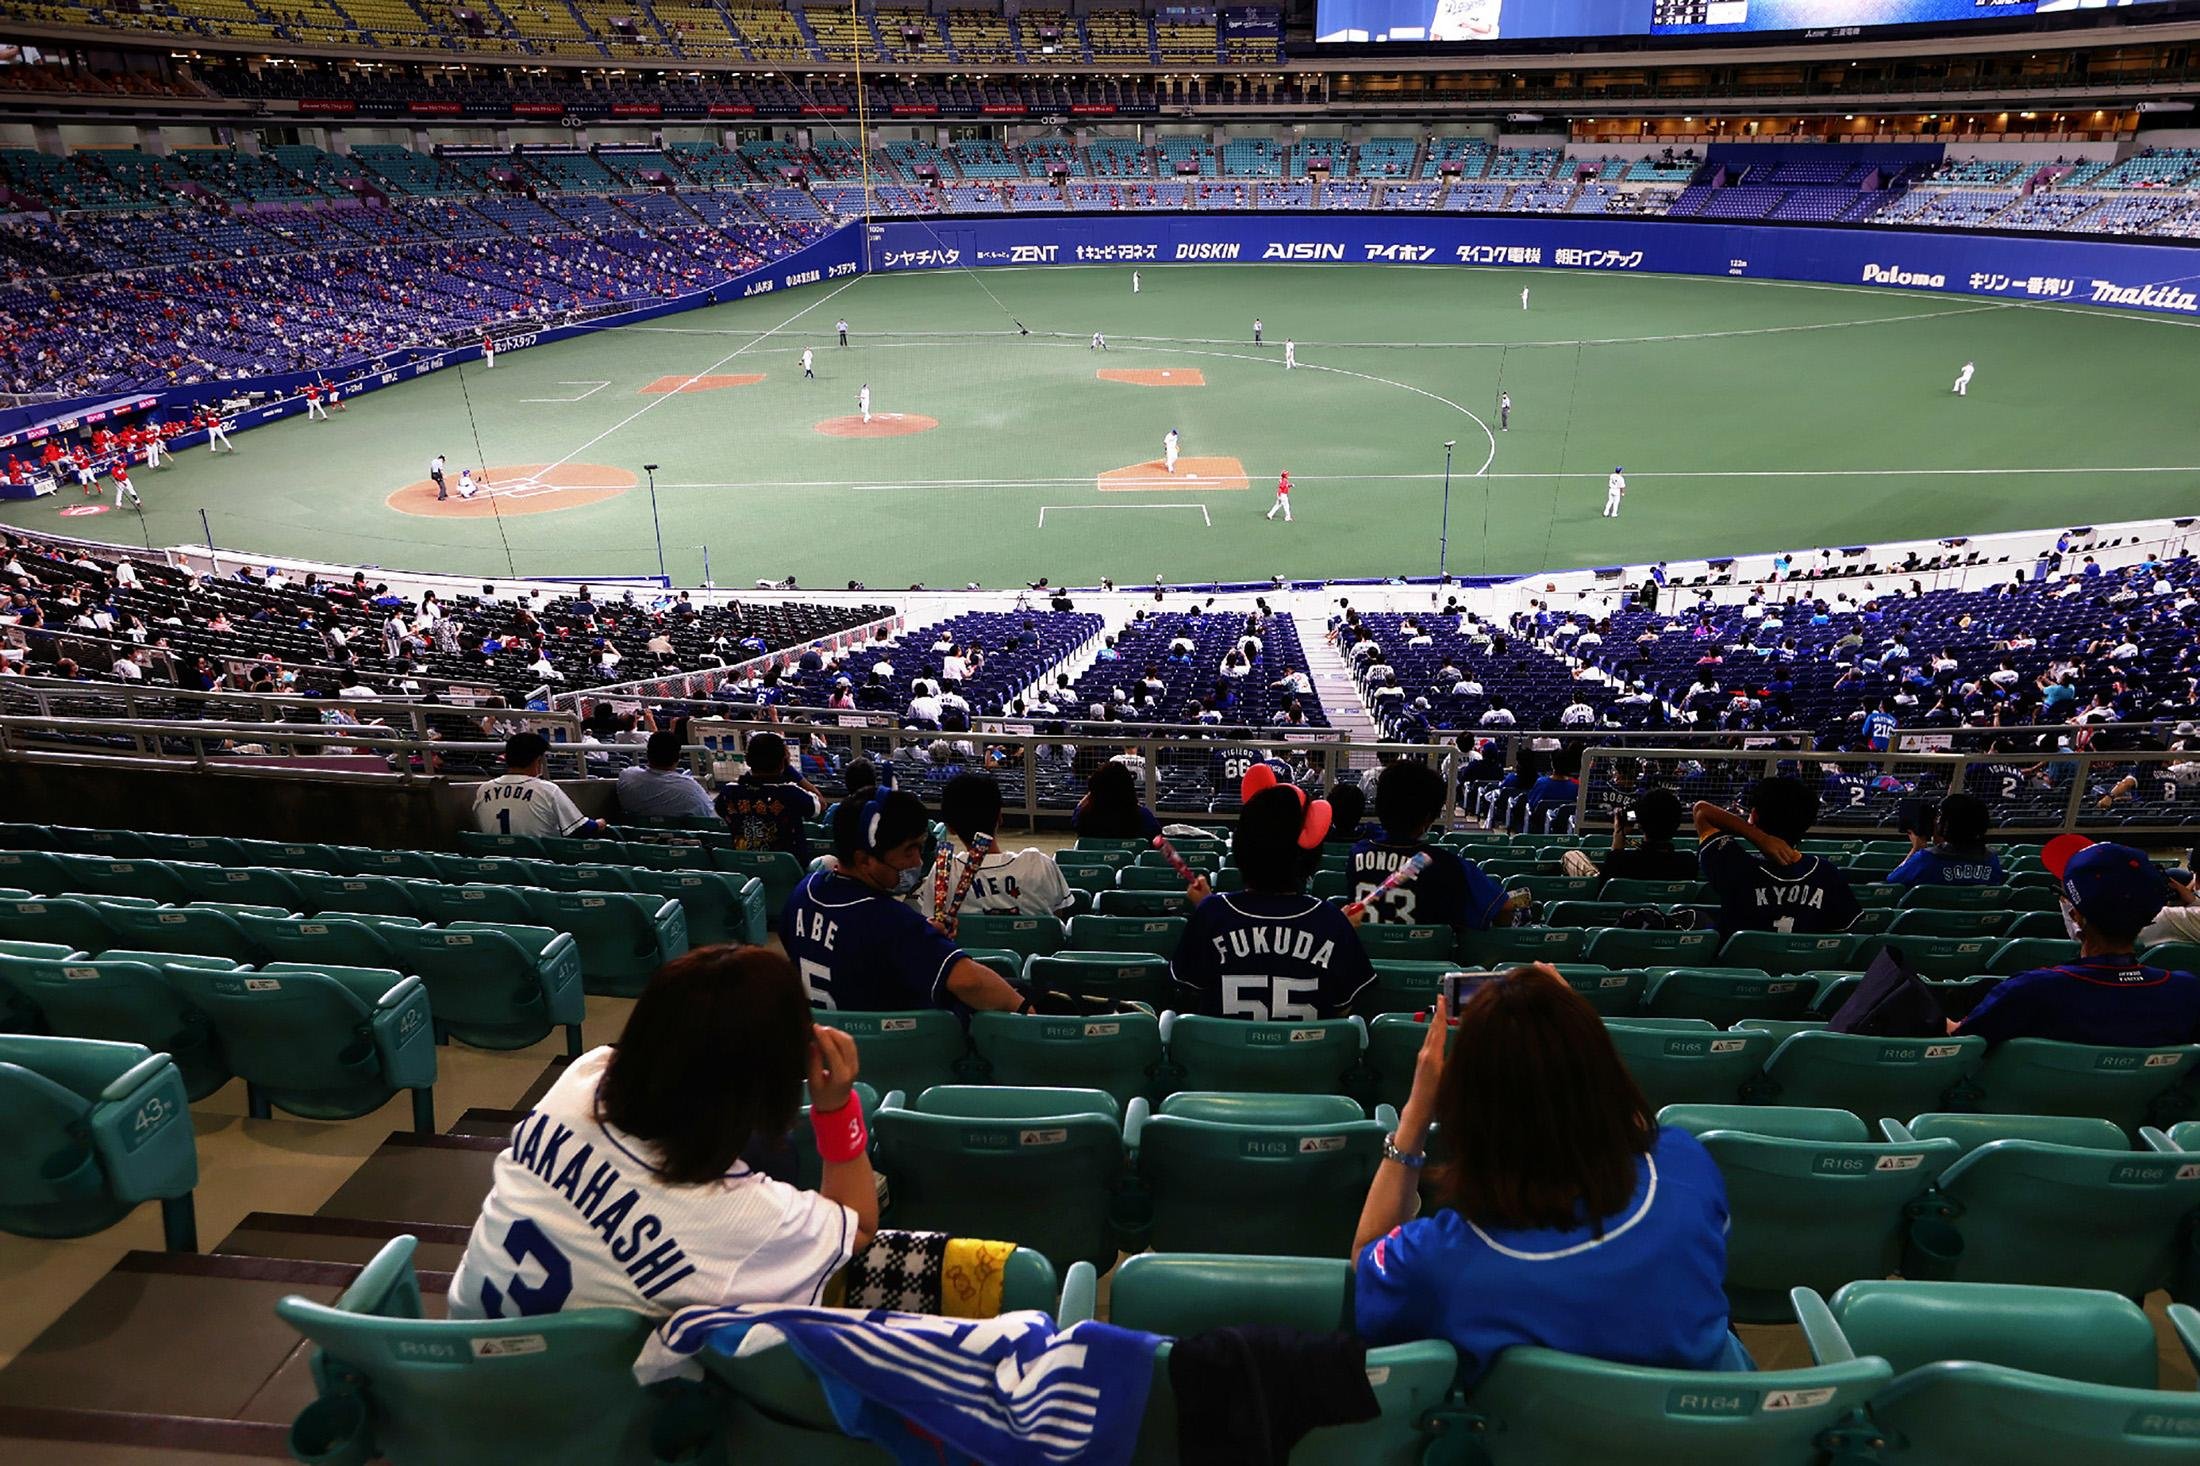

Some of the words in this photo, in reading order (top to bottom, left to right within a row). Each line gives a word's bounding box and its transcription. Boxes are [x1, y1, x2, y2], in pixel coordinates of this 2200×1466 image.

[1010, 245, 1059, 262] ZENT
[1176, 243, 1240, 259] DUSKIN
[1262, 243, 1345, 259] AISIN
[1364, 244, 1436, 261] アイホン
[1456, 246, 1541, 265] ダイコク電機
[1555, 248, 1643, 267] 朝日インテック
[1863, 264, 1945, 288] Paloma
[2089, 279, 2199, 312] Makita
[1224, 758, 1251, 779] 66
[1850, 786, 1866, 806] 2
[2001, 776, 2017, 799] 2
[496, 808, 510, 834] 1
[1942, 864, 1993, 882] SOBUE
[796, 908, 840, 952] ABE
[1212, 926, 1335, 970] FUKUDA
[799, 956, 838, 1011] 5
[1221, 974, 1319, 1022] 55
[1251, 1031, 1282, 1041] R163
[1670, 1042, 1703, 1052] R165
[1884, 1048, 1916, 1059] R166
[2102, 1056, 2136, 1066] R167
[134, 1097, 164, 1131] 43
[849, 1117, 860, 1139] 3
[1247, 1142, 1288, 1154] R163
[1822, 1158, 1864, 1170] R165
[2119, 1167, 2164, 1180] R166
[513, 1110, 696, 1300] TAKAHASHI
[481, 1218, 574, 1319] 3
[1679, 1394, 1741, 1410] R164
